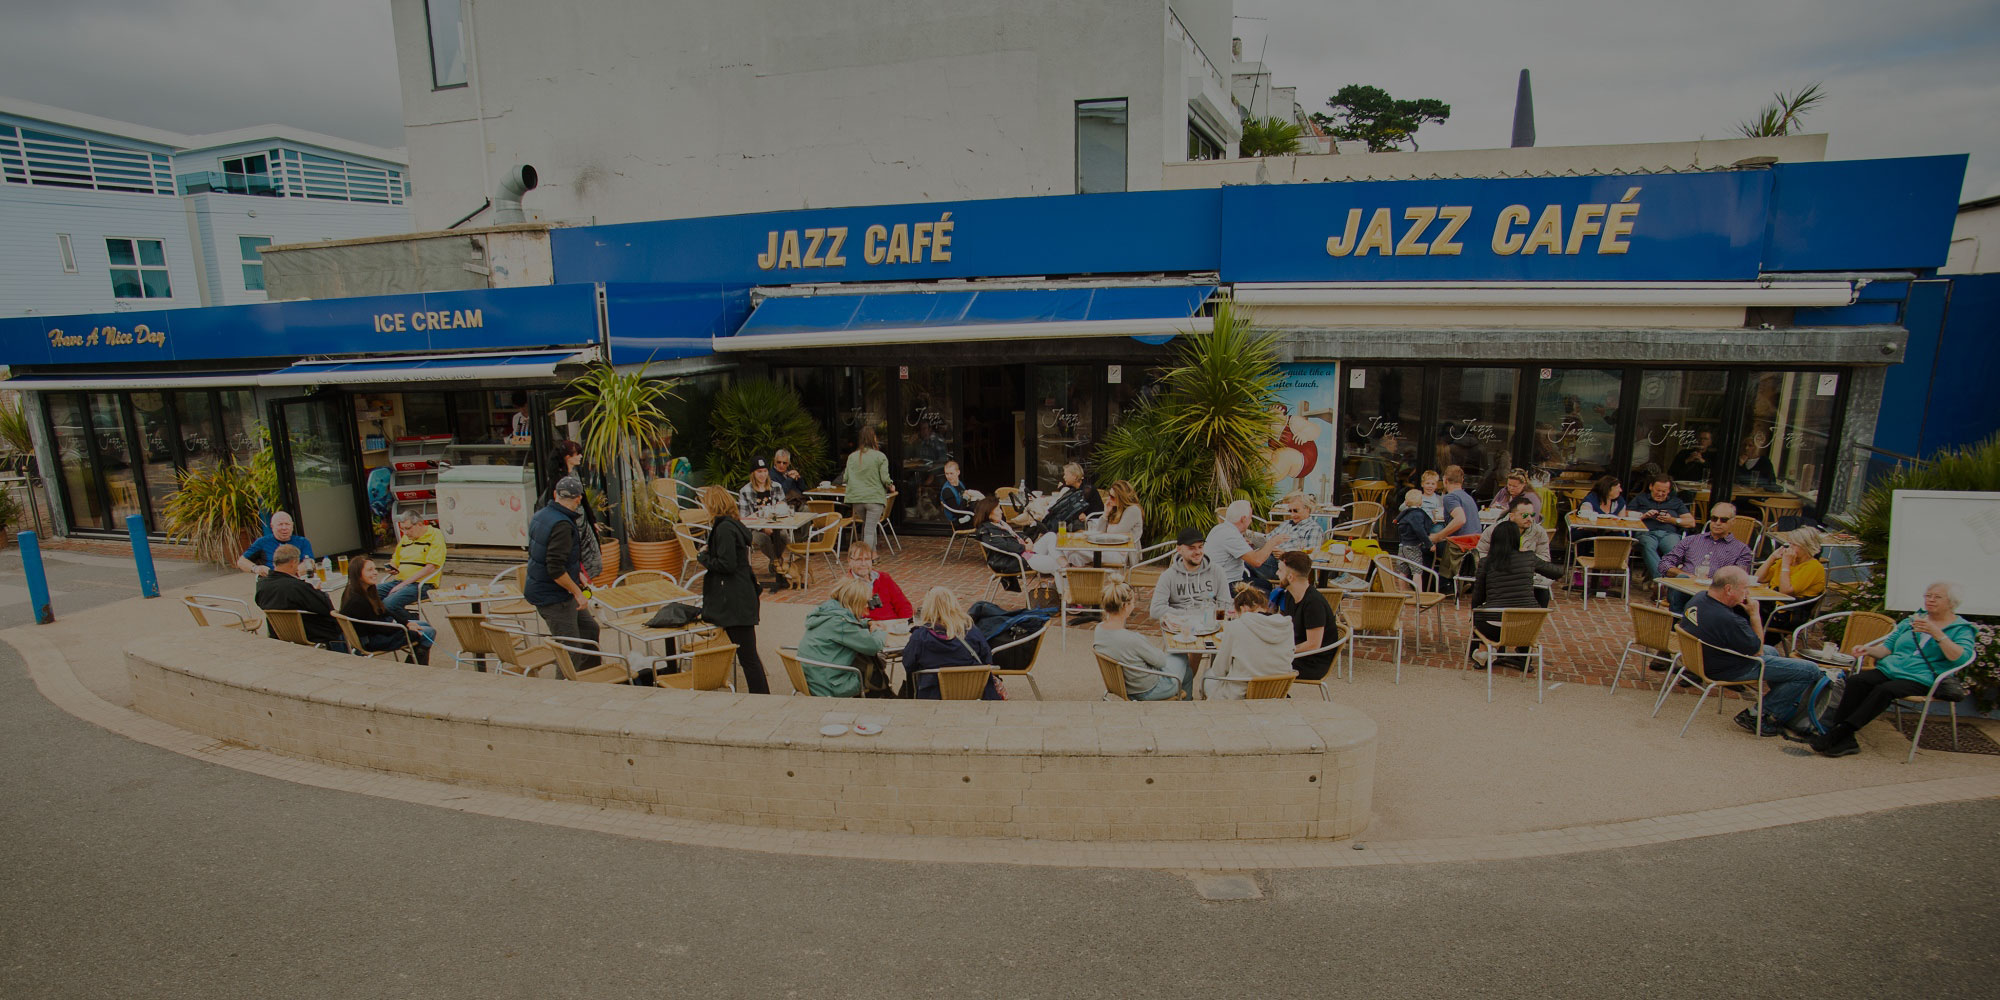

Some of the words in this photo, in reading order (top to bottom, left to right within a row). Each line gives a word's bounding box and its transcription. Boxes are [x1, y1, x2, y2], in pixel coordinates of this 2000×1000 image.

[1326, 205, 1473, 257] JAZZ
[1491, 187, 1642, 256] CAFÉ
[757, 226, 849, 270] JAZZ
[863, 211, 955, 266] CAFÉ
[374, 313, 407, 333] ICE
[411, 308, 484, 331] CREAM
[48, 328, 84, 348] Have
[85, 327, 99, 347] A
[102, 325, 133, 347] Nice
[134, 324, 166, 349] Day
[1309, 368, 1323, 376] like
[1356, 415, 1399, 437] Jazz
[1449, 418, 1494, 440] Jazz
[1547, 421, 1593, 443] Jazz
[1647, 422, 1695, 445] Jazz
[1753, 426, 1804, 449] Jzz
[1176, 580, 1213, 596] WILLS
